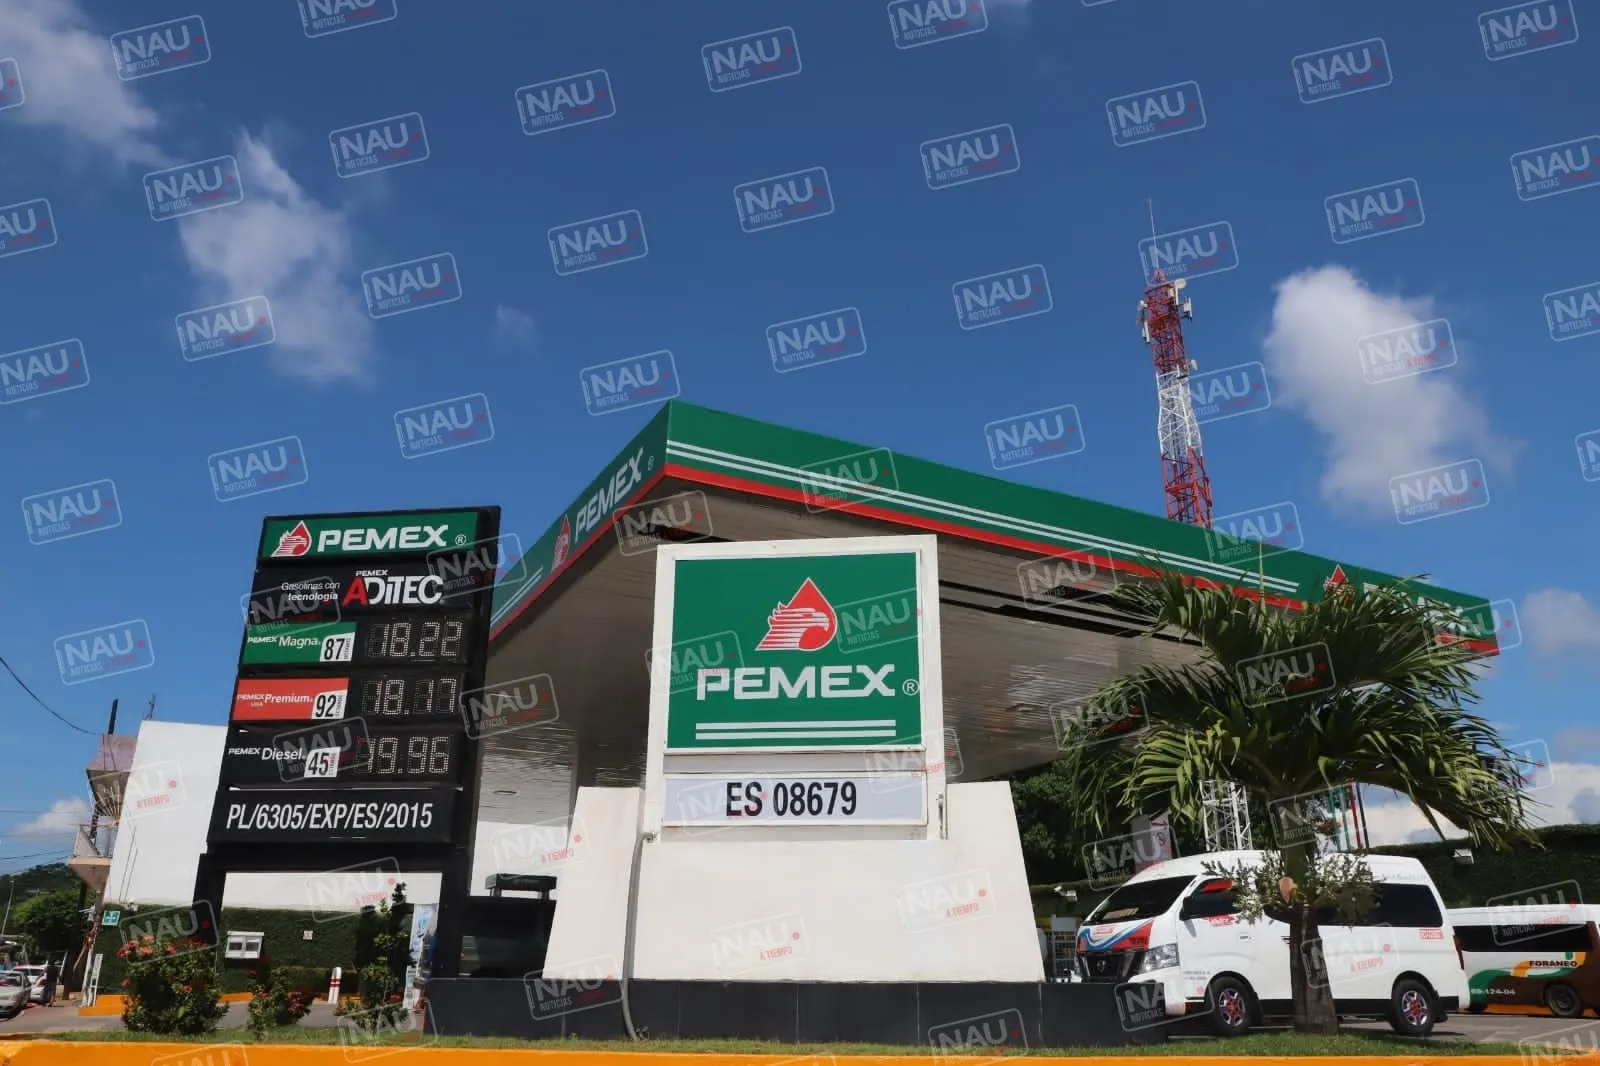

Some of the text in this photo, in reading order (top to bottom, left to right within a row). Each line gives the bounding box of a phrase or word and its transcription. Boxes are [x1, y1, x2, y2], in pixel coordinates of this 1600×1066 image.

[575, 447, 644, 544] PEMEX
[317, 525, 448, 552] PEMEX
[281, 582, 341, 592] Gasolinas con
[288, 592, 338, 602] tecnología
[247, 635, 278, 644] PEMEX
[324, 638, 346, 660] 87
[381, 620, 463, 657] 18.22
[696, 664, 896, 702] PEMEX
[264, 692, 310, 704] Premium
[315, 694, 338, 718] 92
[374, 678, 457, 715] 18.17
[228, 747, 304, 760] PEMEX Diesel
[307, 751, 330, 776] 45
[368, 736, 450, 774] 19.96
[726, 780, 857, 818] ES 08679
[226, 802, 434, 830] PL/6305/EXP/ES/2015
